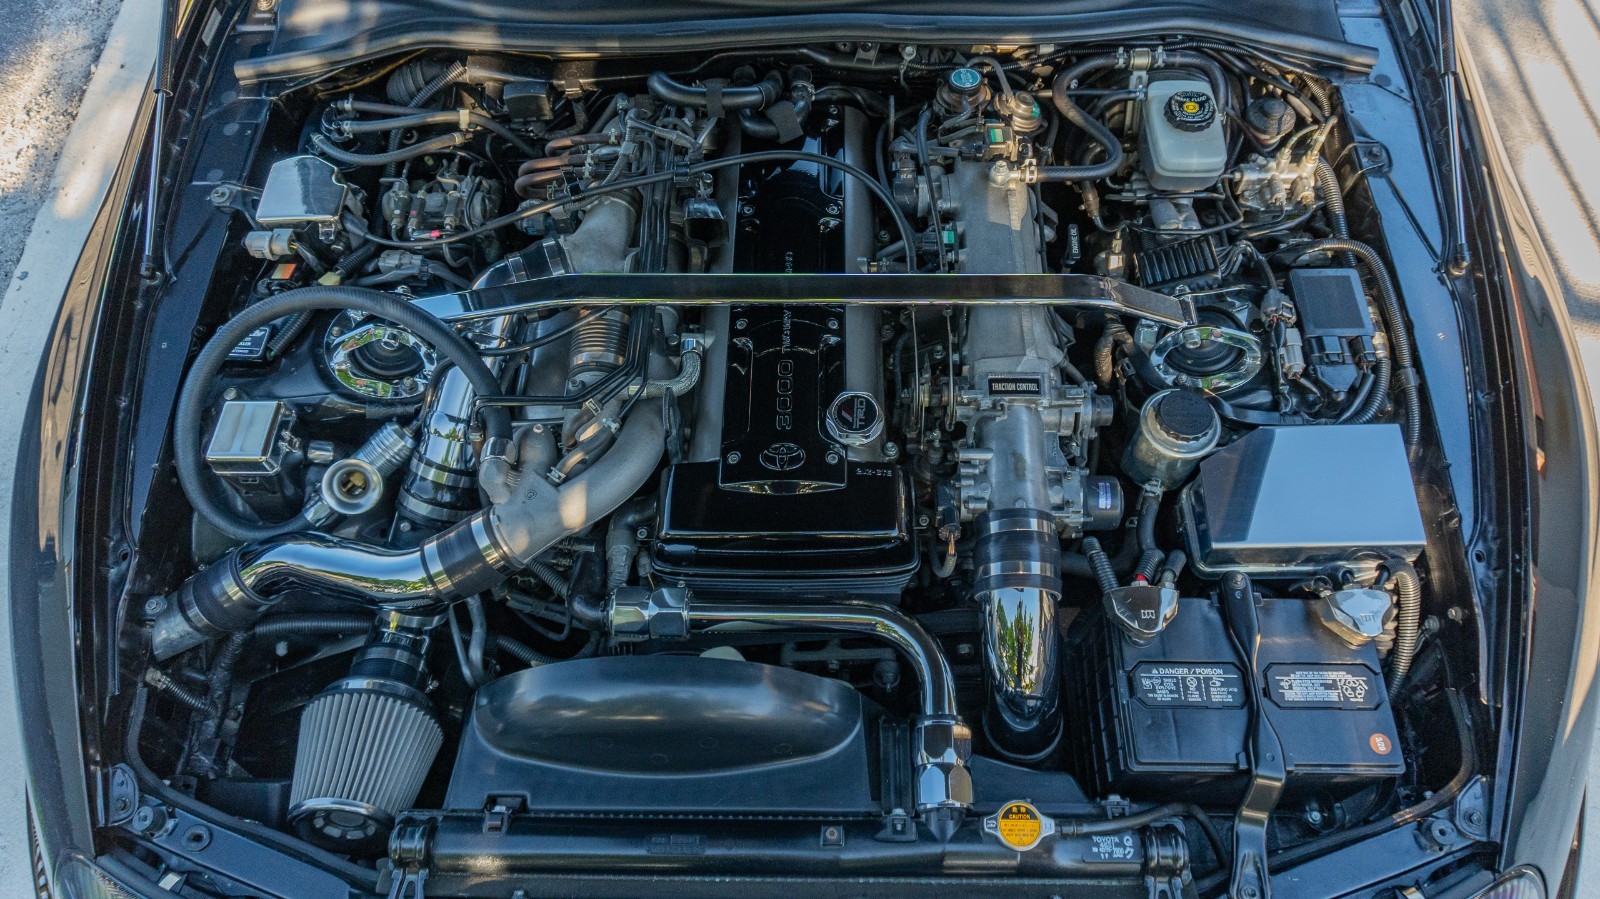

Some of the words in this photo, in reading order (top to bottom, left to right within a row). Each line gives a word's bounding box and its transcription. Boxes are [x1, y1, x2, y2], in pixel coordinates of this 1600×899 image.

[1071, 235, 1079, 254] ENGINE
[776, 359, 794, 431] 3000
[992, 382, 1015, 391] TRACTION
[1016, 382, 1039, 391] CONTROL
[857, 398, 866, 429] TRD
